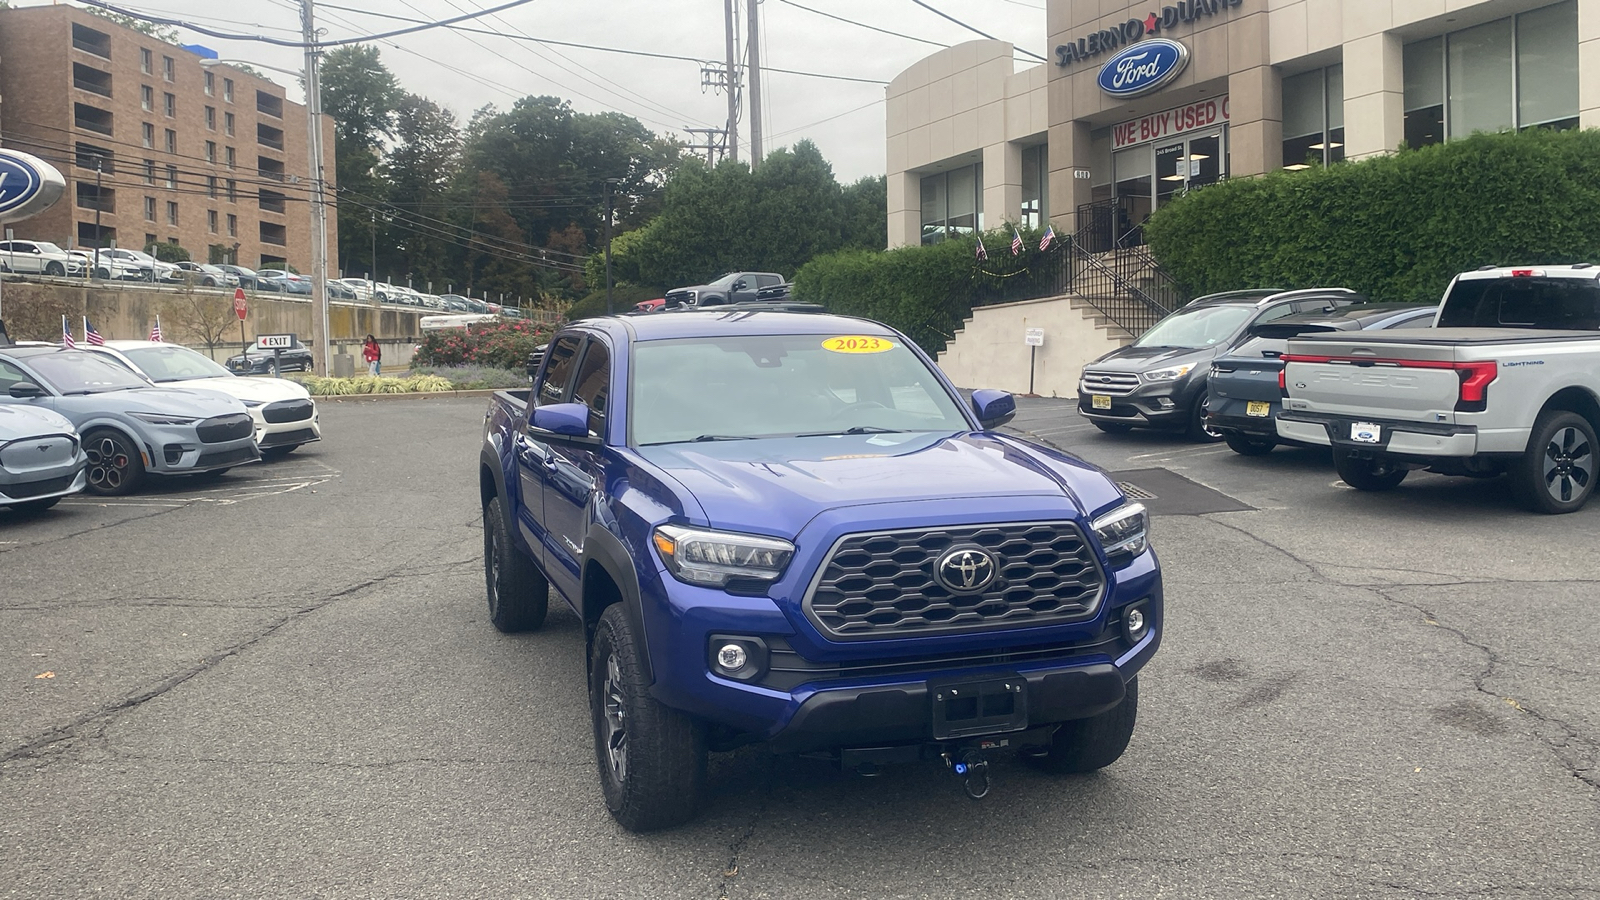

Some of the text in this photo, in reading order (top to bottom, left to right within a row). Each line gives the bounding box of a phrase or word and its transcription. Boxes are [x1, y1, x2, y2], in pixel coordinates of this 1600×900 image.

[1055, 0, 1243, 67] SALERNO DUAN
[1112, 52, 1161, 88] Ford
[1114, 121, 1137, 147] WE
[1140, 112, 1170, 140] BUY
[1174, 100, 1217, 132] USED
[1165, 146, 1177, 154] Broad
[235, 298, 247, 311] STOP
[269, 337, 288, 346] EXIT
[835, 338, 880, 350] 2023
